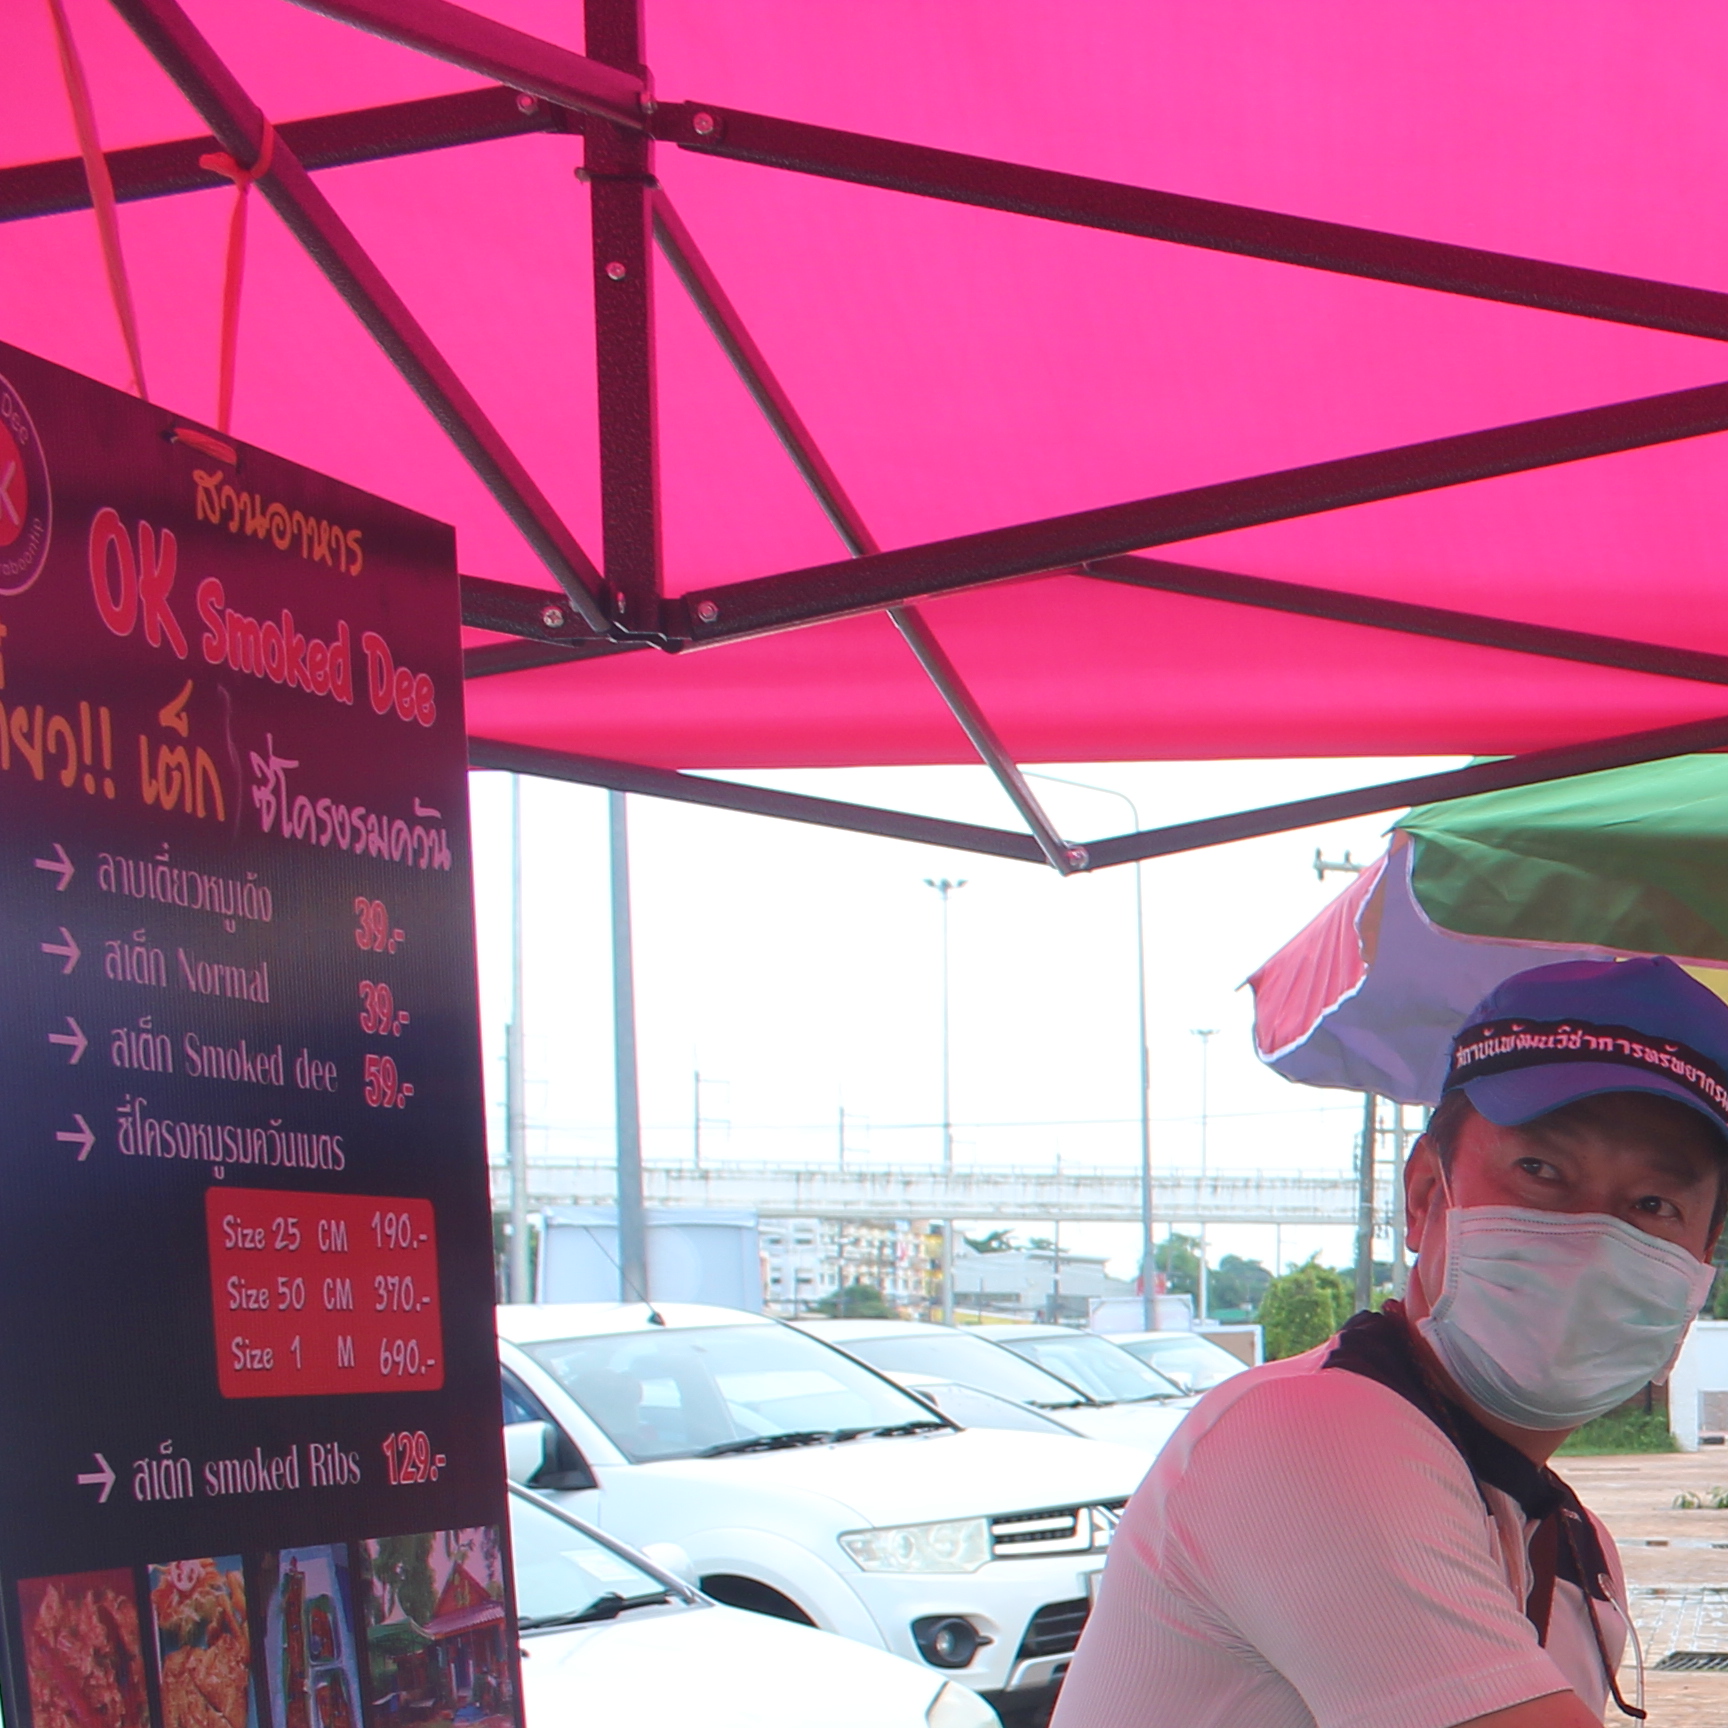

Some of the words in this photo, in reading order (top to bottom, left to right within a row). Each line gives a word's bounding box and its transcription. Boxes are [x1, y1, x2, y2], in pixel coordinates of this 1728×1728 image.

[192, 469, 363, 577] สวนอาหาร
[88, 507, 189, 660] OK
[197, 577, 354, 704] Smoked
[363, 631, 437, 727] Dee
[354, 896, 406, 954] 39.-
[104, 928, 167, 987] สเต็ก
[177, 947, 270, 1004] Normal
[358, 980, 410, 1037] 39.-
[110, 1015, 174, 1074] สเต็ก
[184, 1031, 285, 1087] Smoked
[295, 1047, 338, 1093] dee
[364, 1054, 414, 1109] 59.-
[222, 1214, 266, 1250] Size
[271, 1217, 301, 1250] 25
[318, 1219, 348, 1252] CM
[371, 1210, 428, 1249] 190.-
[227, 1275, 270, 1310] Size
[278, 1277, 305, 1310] 50
[323, 1278, 353, 1310] CM
[374, 1275, 431, 1312] 370.-
[231, 1336, 274, 1371] Size
[291, 1335, 301, 1369] 1
[337, 1335, 355, 1368] M
[380, 1338, 435, 1376] 690.-
[133, 1440, 194, 1502] สเต็ก
[204, 1443, 300, 1497] smoked
[309, 1440, 361, 1489] Ribs
[382, 1431, 447, 1486] 129.-
